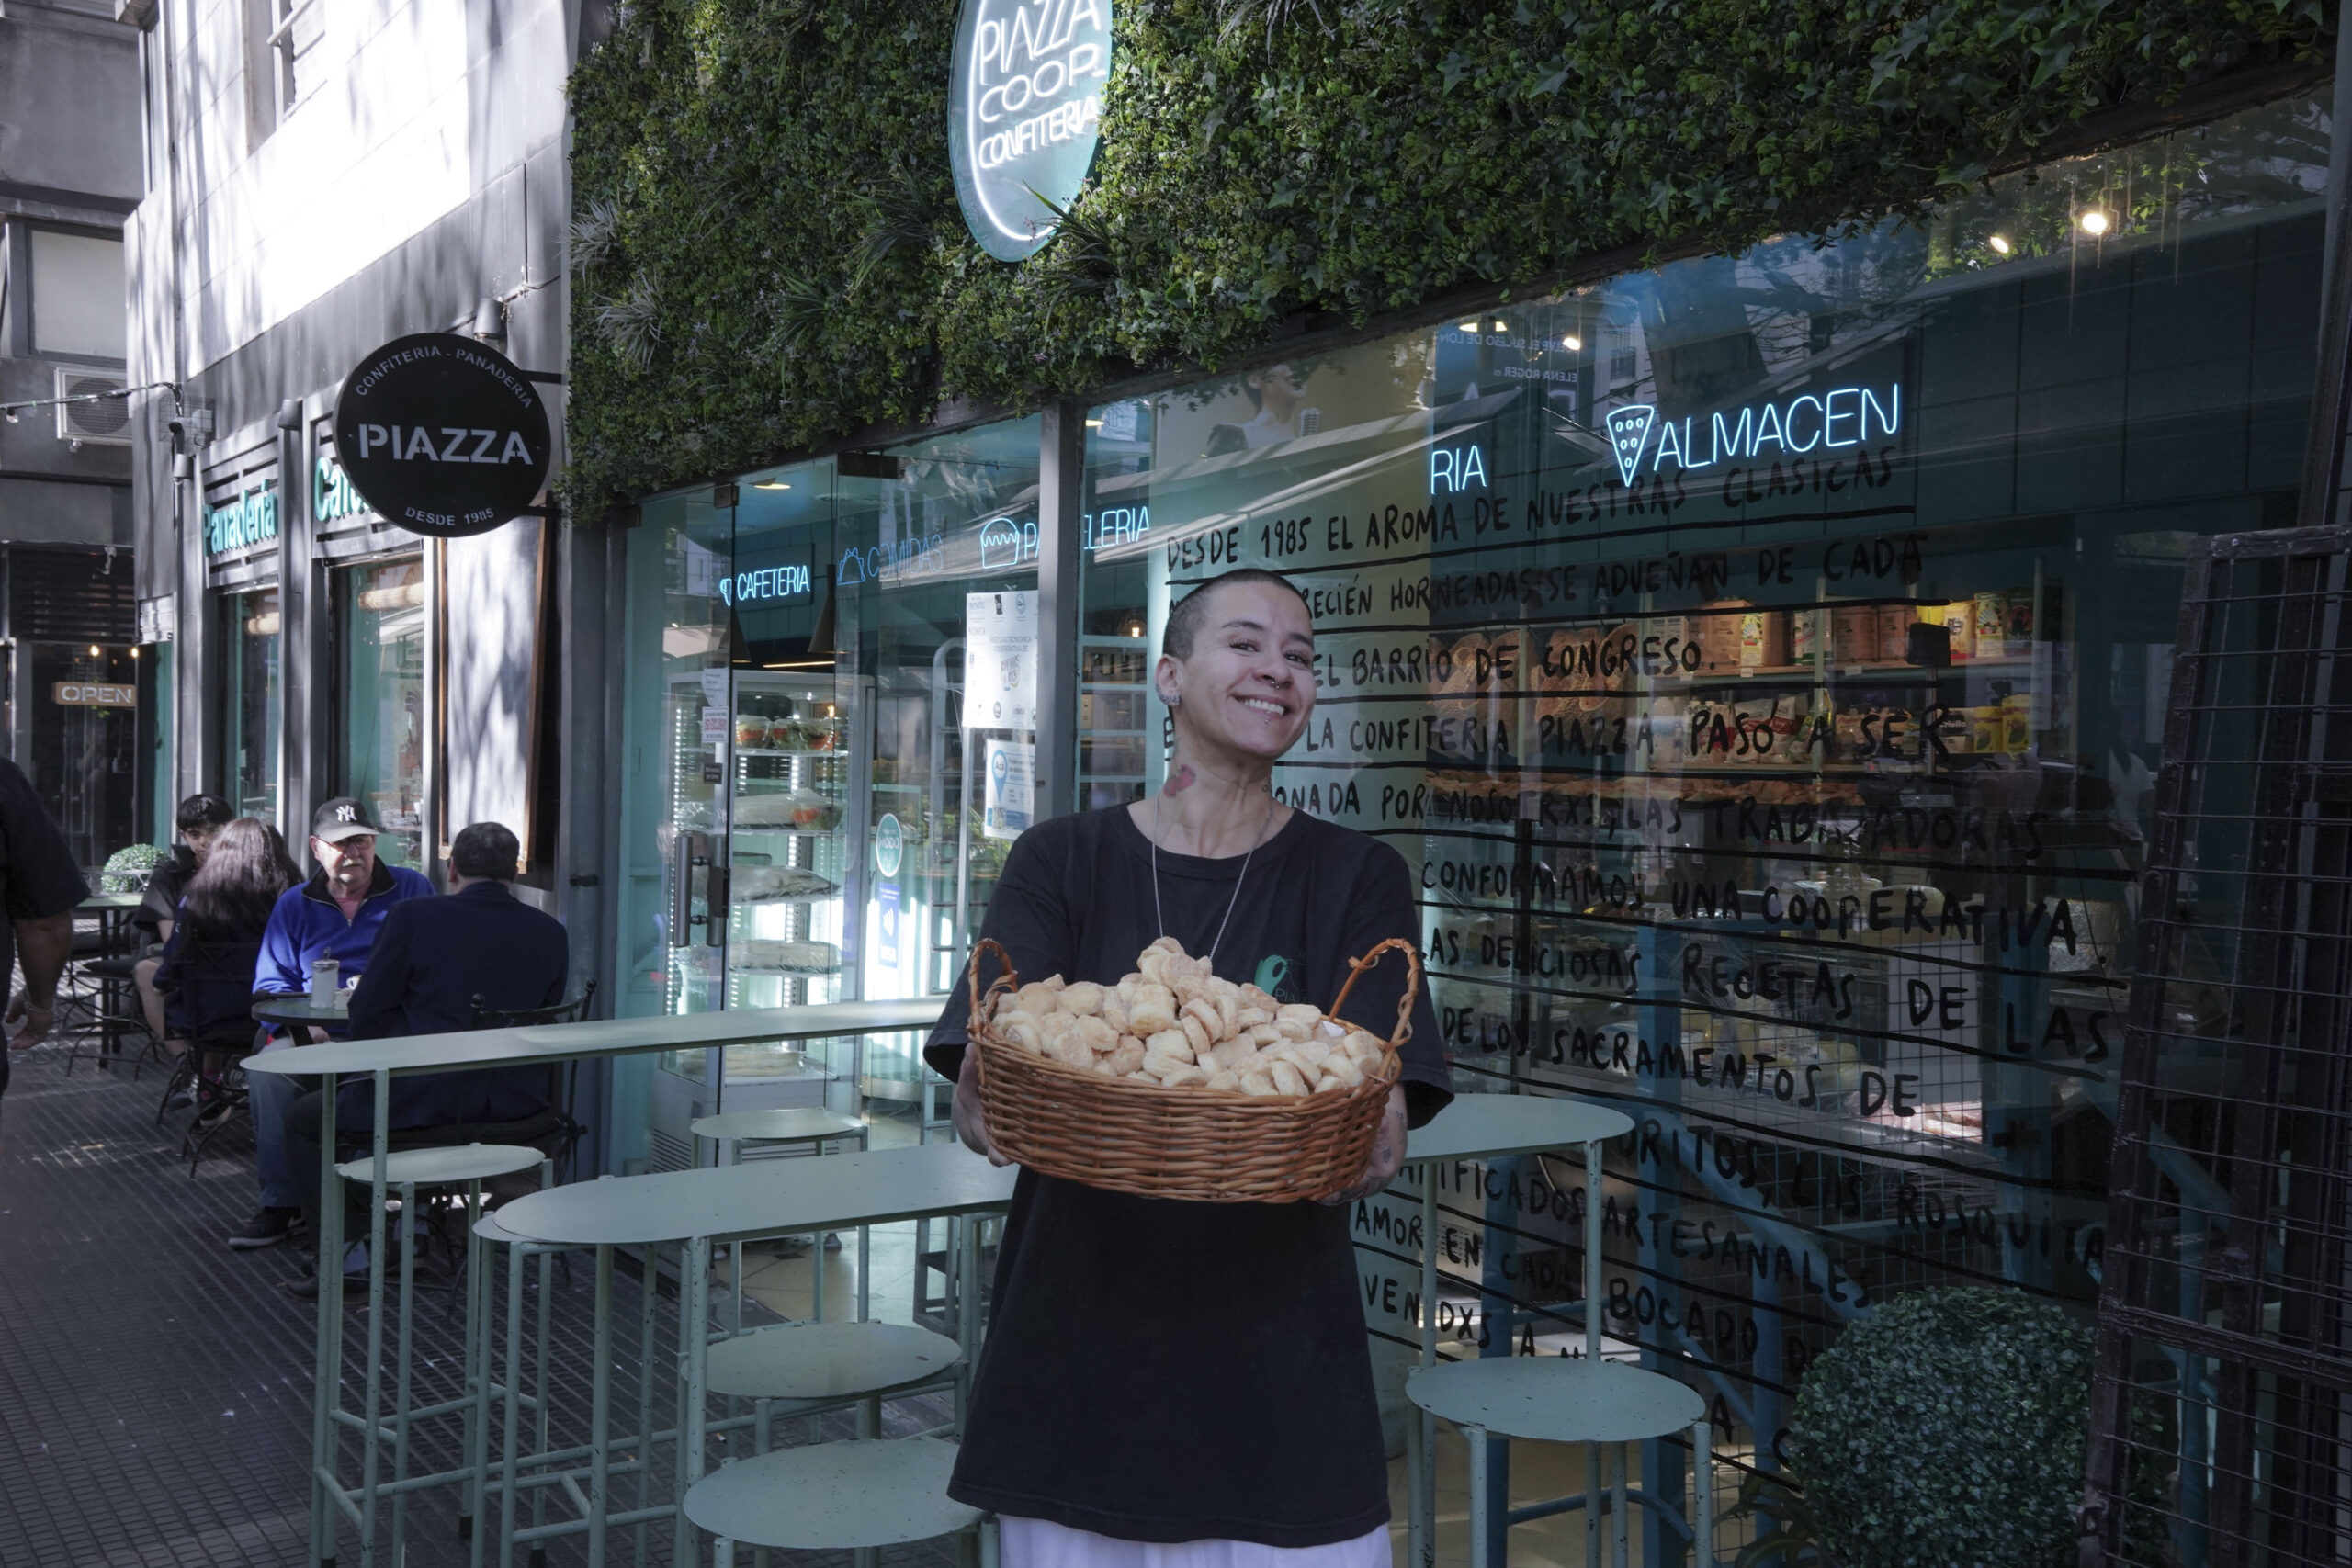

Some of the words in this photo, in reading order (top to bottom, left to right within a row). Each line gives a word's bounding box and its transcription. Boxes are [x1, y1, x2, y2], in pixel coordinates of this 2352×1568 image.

[980, 0, 1101, 85] PIAZZA
[978, 96, 1100, 169] CONFITERIA
[356, 345, 441, 396] CONFITERIA
[456, 348, 533, 409] PANADERIA
[357, 423, 534, 465] PIAZZA
[1653, 382, 1899, 472] ALMACEN
[202, 478, 277, 557] Panadería
[404, 506, 456, 526] DESDE
[463, 507, 494, 525] 1985
[1167, 526, 1239, 574] DESDE
[1261, 516, 1311, 558] 1985
[1327, 516, 1354, 552] EL
[1366, 502, 1458, 550] AROMA
[1475, 496, 1510, 536] DE
[1527, 467, 1687, 531] NUESTRAS
[1723, 445, 1893, 509] CLASICAS
[737, 564, 810, 602] CAFETERIA
[867, 533, 944, 578] COMIDAS
[1391, 568, 1534, 613] HORNEADAS
[1548, 565, 1577, 602] SE
[1594, 551, 1728, 599] ADUEÑAN
[1758, 547, 1794, 585] DE
[1824, 534, 1922, 581] CADA
[61, 685, 131, 703] OPEN
[1352, 641, 1453, 686] BARRIO
[1476, 645, 1520, 686] DE
[1306, 716, 1335, 753] LA
[1350, 713, 1510, 755] CONFITERIA
[1540, 713, 1654, 758] PIAZZA
[1807, 715, 1833, 754] A
[1860, 703, 1950, 763] SER
[1382, 783, 1425, 821] POR
[1627, 797, 1682, 834] LAS
[1421, 860, 1644, 912] CONFORMAMOS
[1672, 879, 1743, 920] UNA
[1761, 886, 2077, 956] COOPERATIVA
[1422, 927, 1459, 965] AS
[1481, 934, 1642, 995] DELICIOSAS
[1683, 942, 1856, 1020] RECETAS
[1909, 979, 1969, 1030] DE
[2004, 1002, 2109, 1064] LAS
[1552, 1028, 1821, 1107] SACRAMENTOS
[1861, 1071, 1919, 1118] DE
[1355, 1198, 1423, 1250] AMOR
[1446, 1227, 1480, 1268] EN
[1609, 1277, 1758, 1360] BOCADO
